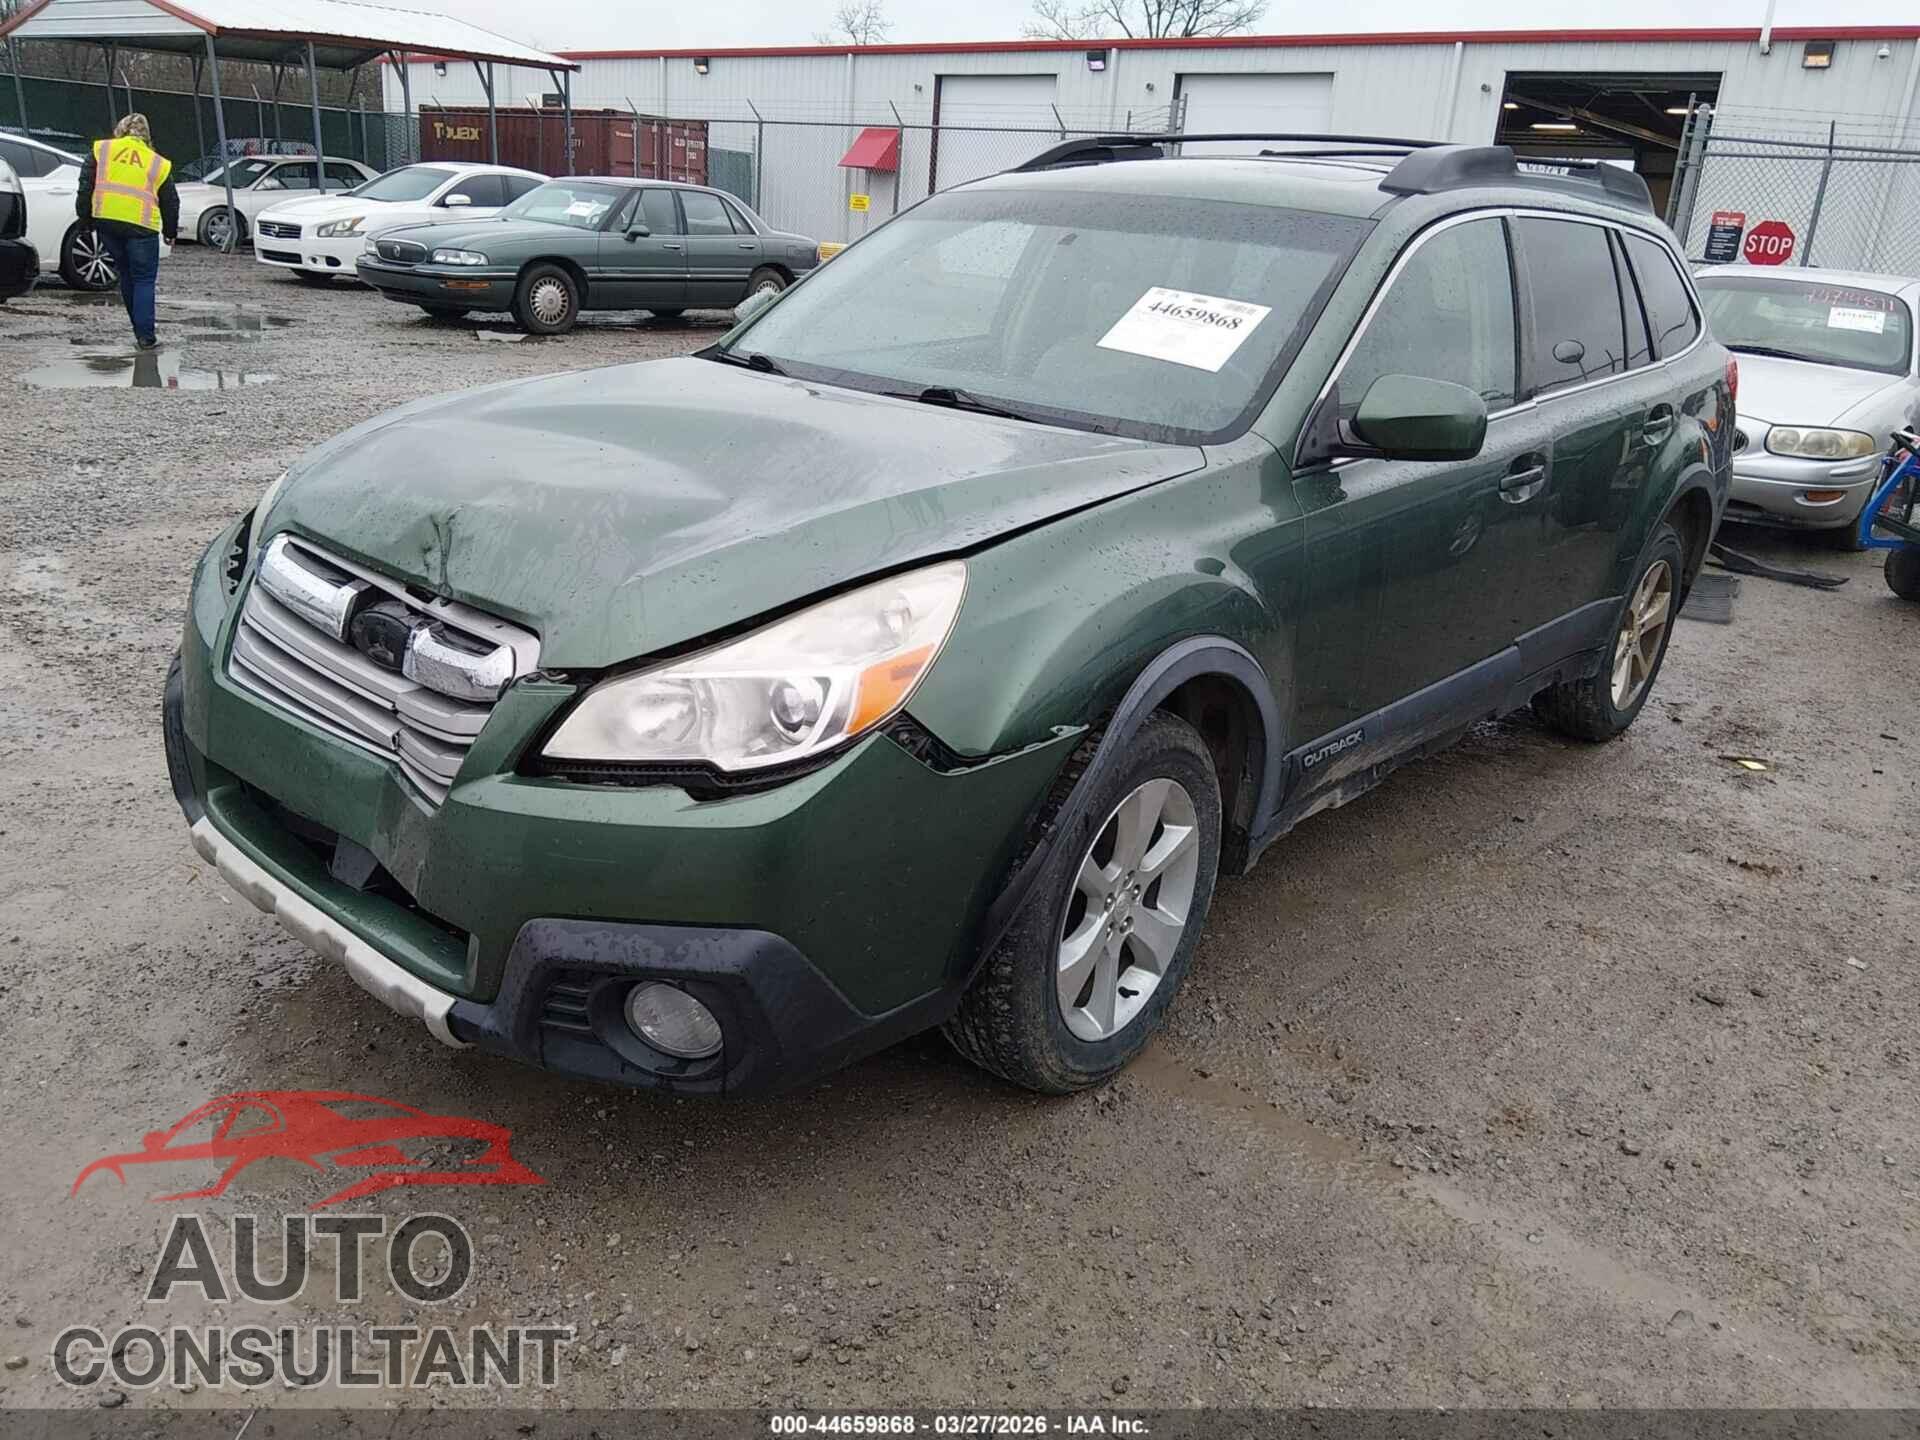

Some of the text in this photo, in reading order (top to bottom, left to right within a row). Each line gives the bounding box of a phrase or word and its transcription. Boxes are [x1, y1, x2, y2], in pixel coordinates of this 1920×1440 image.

[1746, 234, 1792, 256] STOP
[1148, 300, 1243, 331] 44659868
[1303, 729, 1363, 768] OUTBACK
